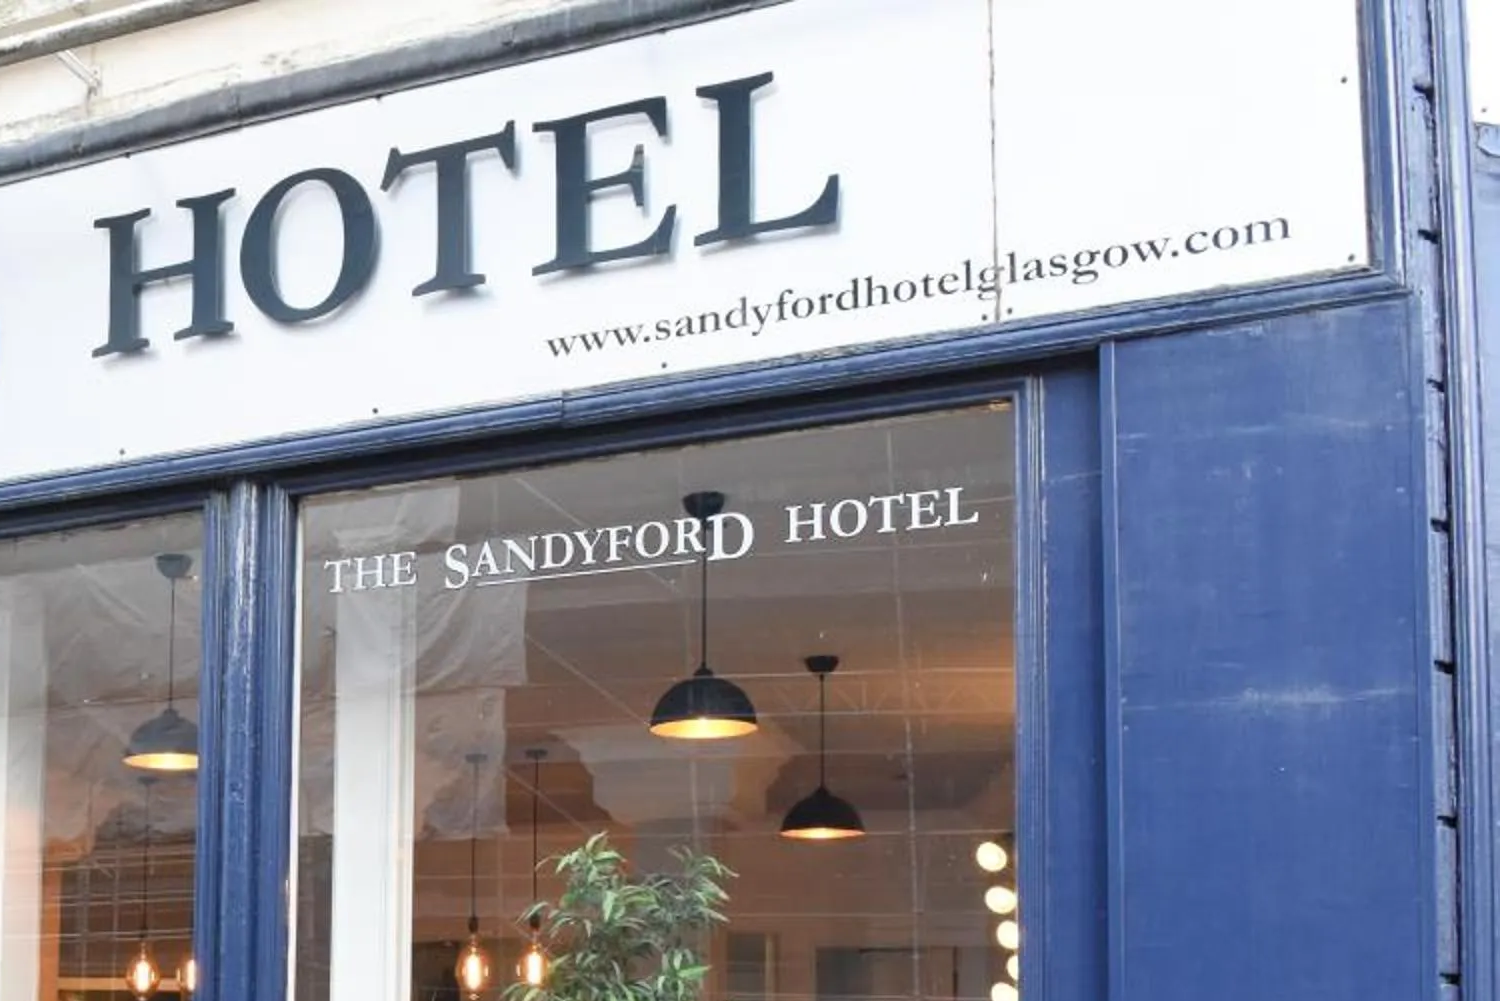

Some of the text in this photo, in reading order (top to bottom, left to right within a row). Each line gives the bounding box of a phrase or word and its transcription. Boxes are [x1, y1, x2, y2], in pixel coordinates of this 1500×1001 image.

[92, 71, 840, 358] HOTEL
[545, 214, 1291, 358] www.sandyfordhotelglasgow.com
[323, 487, 980, 594] THE SANDYFORD HOTEL
